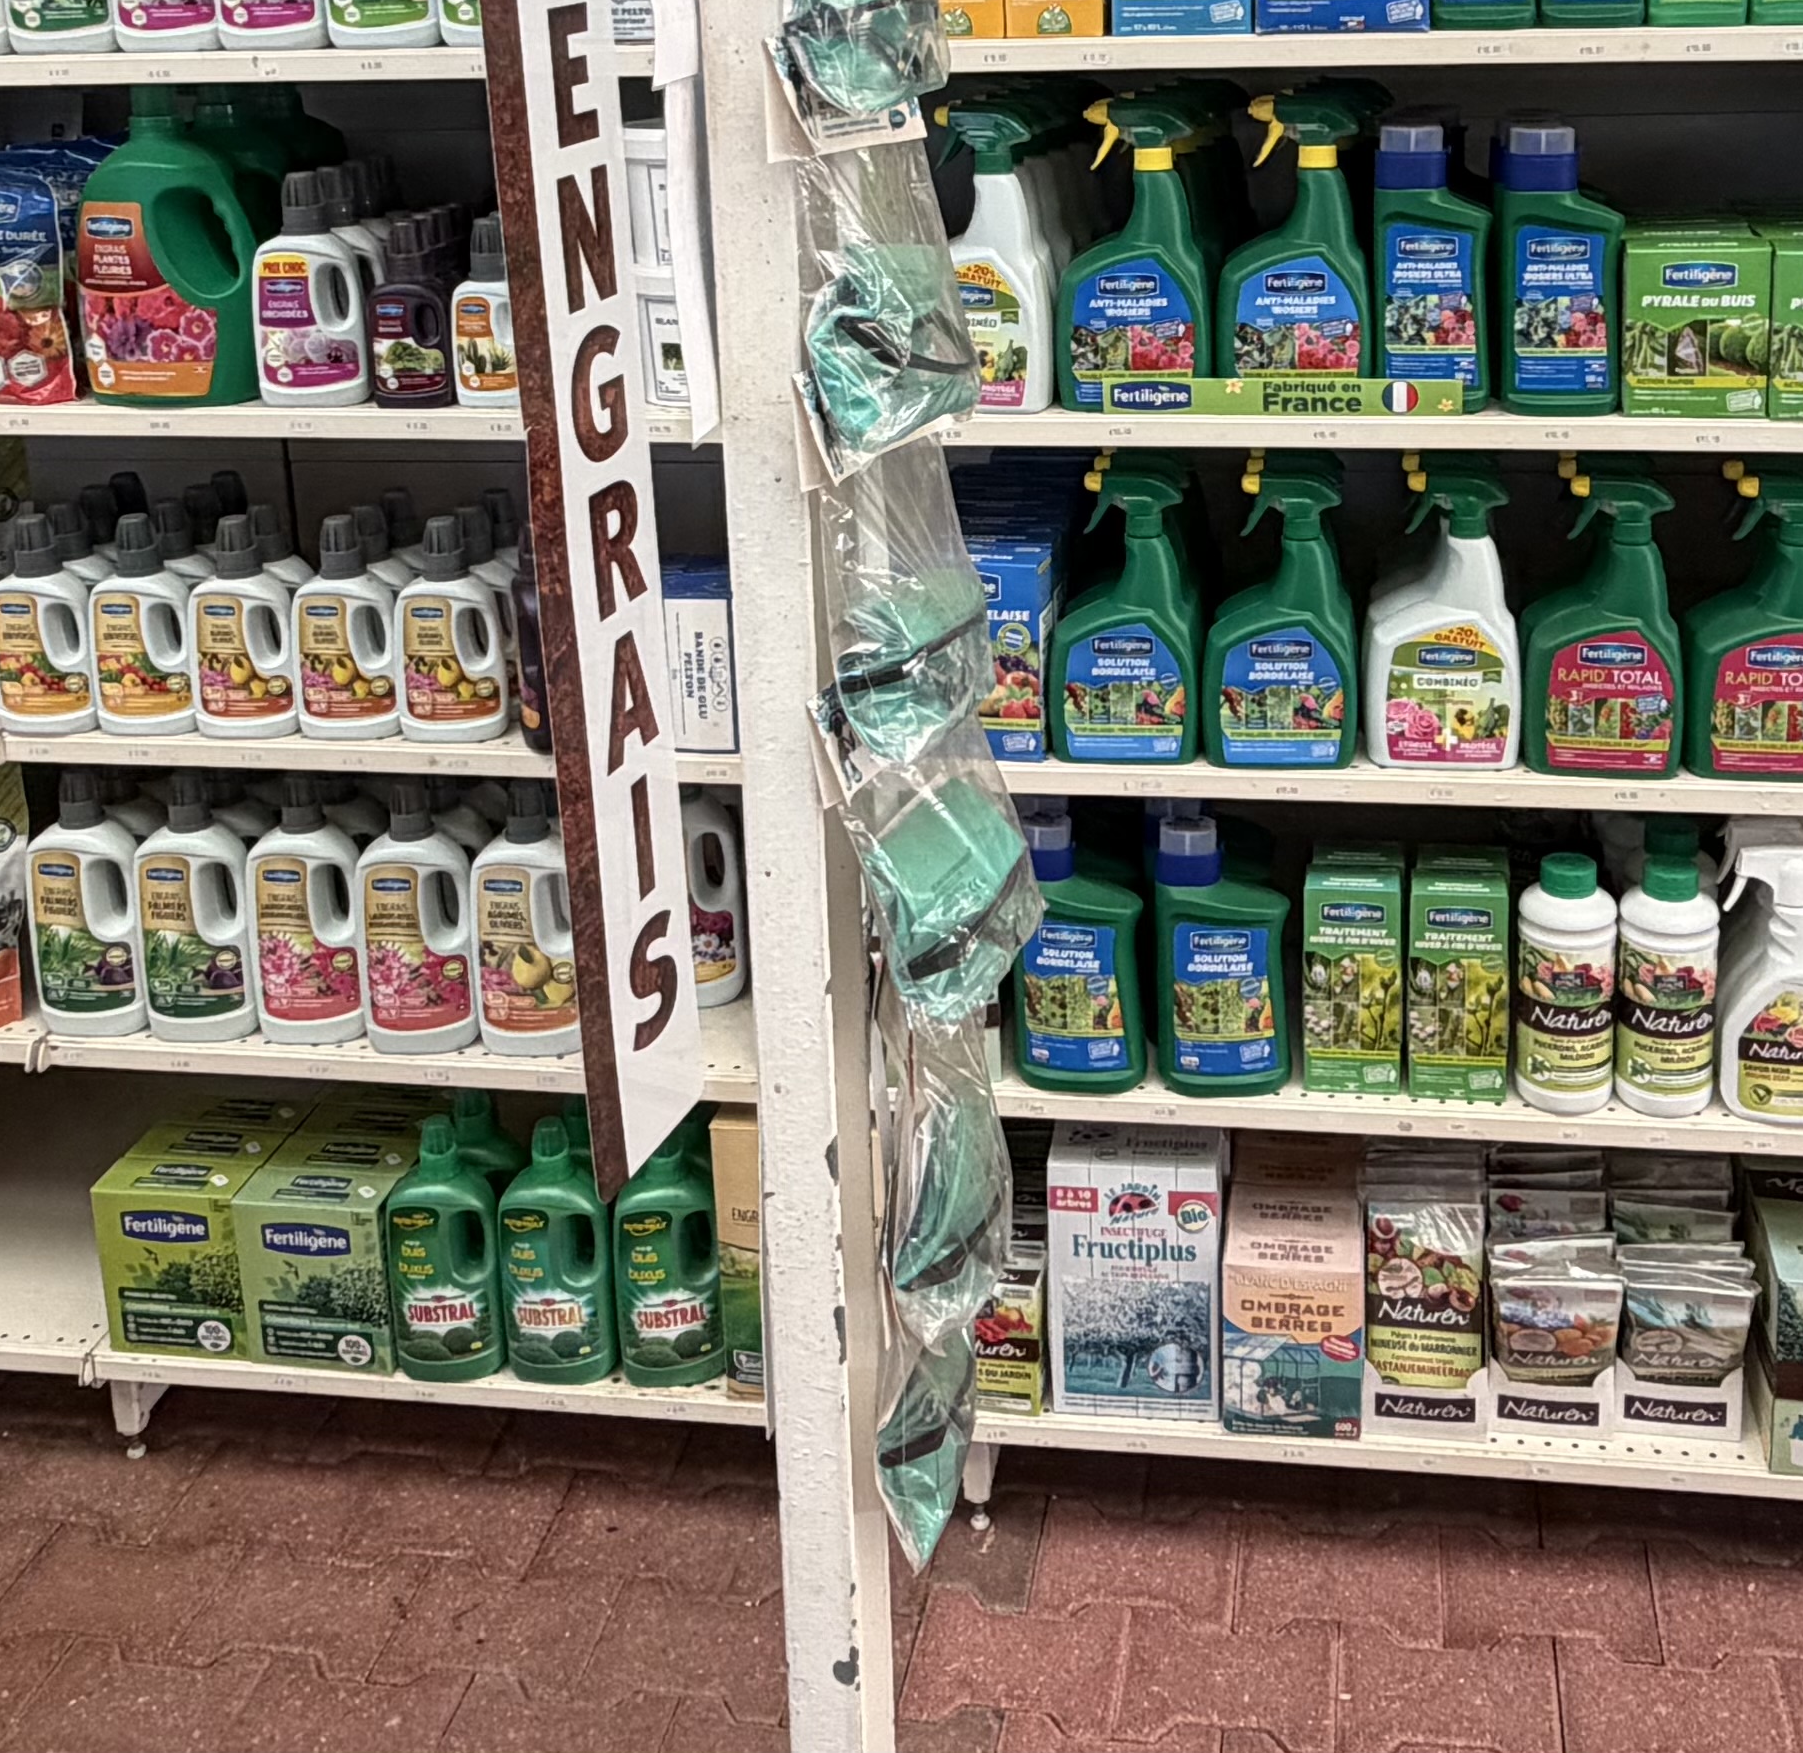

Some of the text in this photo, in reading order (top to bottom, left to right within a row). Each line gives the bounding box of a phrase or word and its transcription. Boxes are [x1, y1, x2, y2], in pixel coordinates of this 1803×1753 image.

[1641, 294, 1756, 308] PYRALE BUIS
[1113, 386, 1190, 407] Fertiligène
[1262, 381, 1362, 397] Fabriqué en
[1262, 394, 1362, 414] France
[547, 2, 679, 1053] ENGRAIS
[1097, 658, 1150, 668] SOLUTION
[1582, 646, 1644, 664] Fertiligène
[684, 652, 694, 698] PELTON
[1091, 667, 1156, 677] BORDELAISE
[1254, 661, 1308, 672] SOLUTION
[1612, 670, 1662, 685] TOTAL
[1056, 1199, 1092, 1208] arbres
[1180, 1208, 1209, 1223] Bio
[122, 1213, 207, 1241] Fertiligène
[1101, 1227, 1167, 1238] INSECTIFUGE
[264, 1227, 349, 1254] Fertiligène
[1073, 1234, 1197, 1266] Fructiplus
[408, 1301, 477, 1324] SUBSTRAL
[516, 1305, 584, 1327] SUBSTRAL
[636, 1302, 706, 1329] SUBSTRAL
[1241, 1299, 1345, 1318] OMBRAGE
[1378, 1300, 1470, 1326] Naturen
[1380, 1399, 1471, 1418] Naturen
[1503, 1400, 1596, 1421] Naturen
[1630, 1401, 1722, 1422] Naturen
